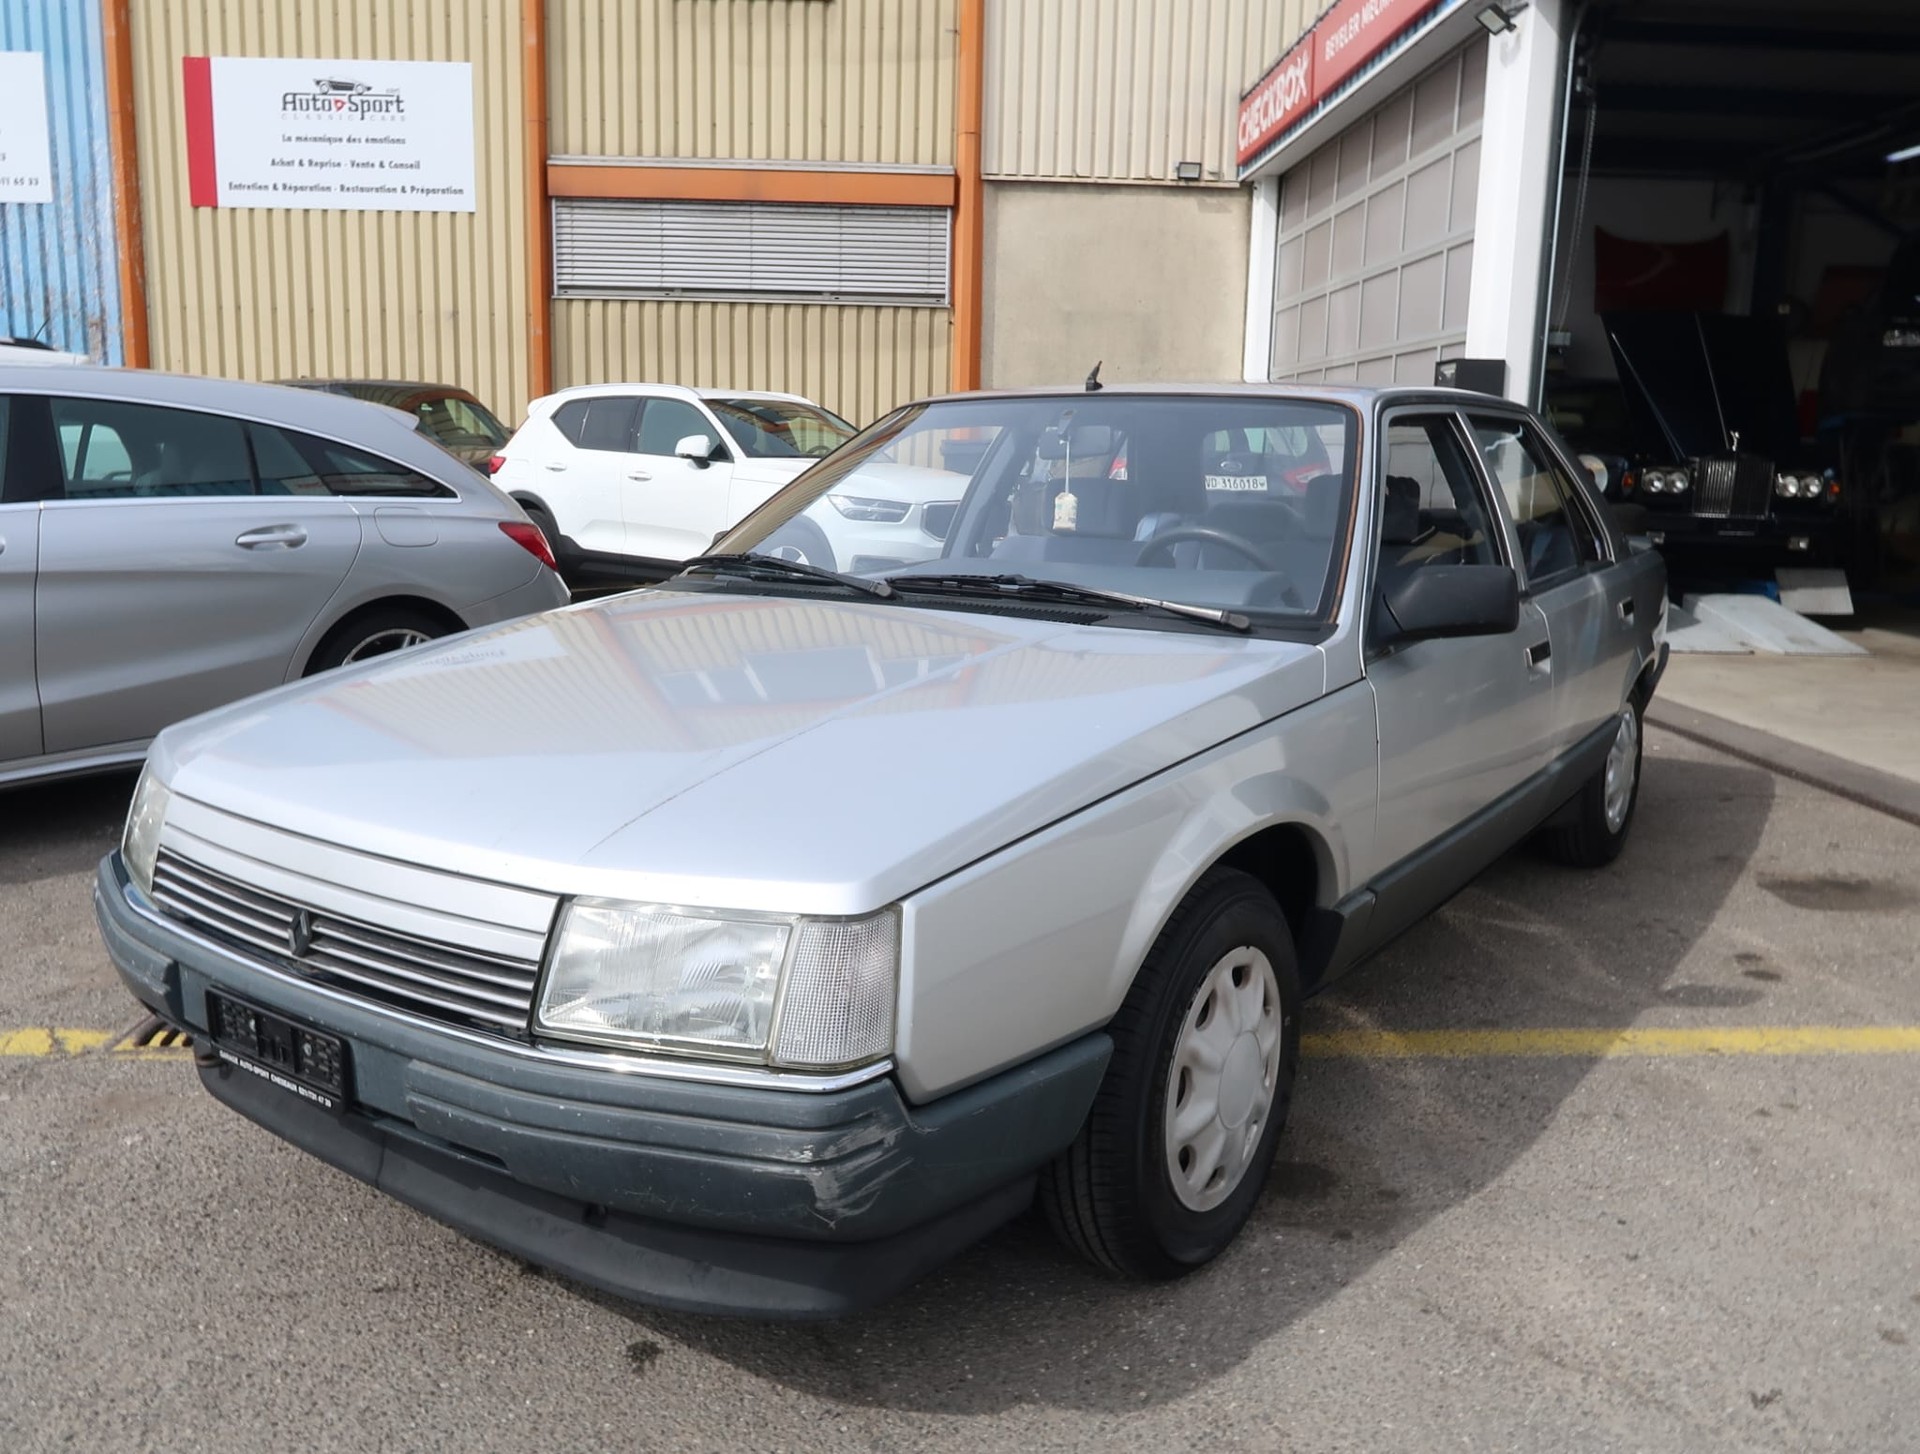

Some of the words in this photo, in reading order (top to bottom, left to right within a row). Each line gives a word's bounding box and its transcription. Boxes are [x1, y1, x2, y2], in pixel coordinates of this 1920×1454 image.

[282, 92, 333, 112] Auto
[347, 93, 405, 121] Sport
[1238, 49, 1309, 152] CHECKBOX
[282, 134, 293, 143] La
[295, 134, 344, 145] mécanique
[346, 134, 362, 144] des
[364, 135, 407, 144] émotions
[270, 158, 295, 167] Achat
[298, 159, 305, 167] &
[308, 159, 342, 170] Reprise
[350, 160, 376, 168] Vente
[379, 160, 386, 168] &
[388, 160, 421, 169] Conseil
[228, 181, 269, 191] Entretien
[272, 183, 279, 191] &
[282, 183, 332, 194] Réparation
[339, 184, 398, 193] Restauration
[401, 185, 408, 193] &
[410, 186, 465, 196] Préparation
[1206, 478, 1218, 489] VD
[1221, 478, 1259, 490] 316018
